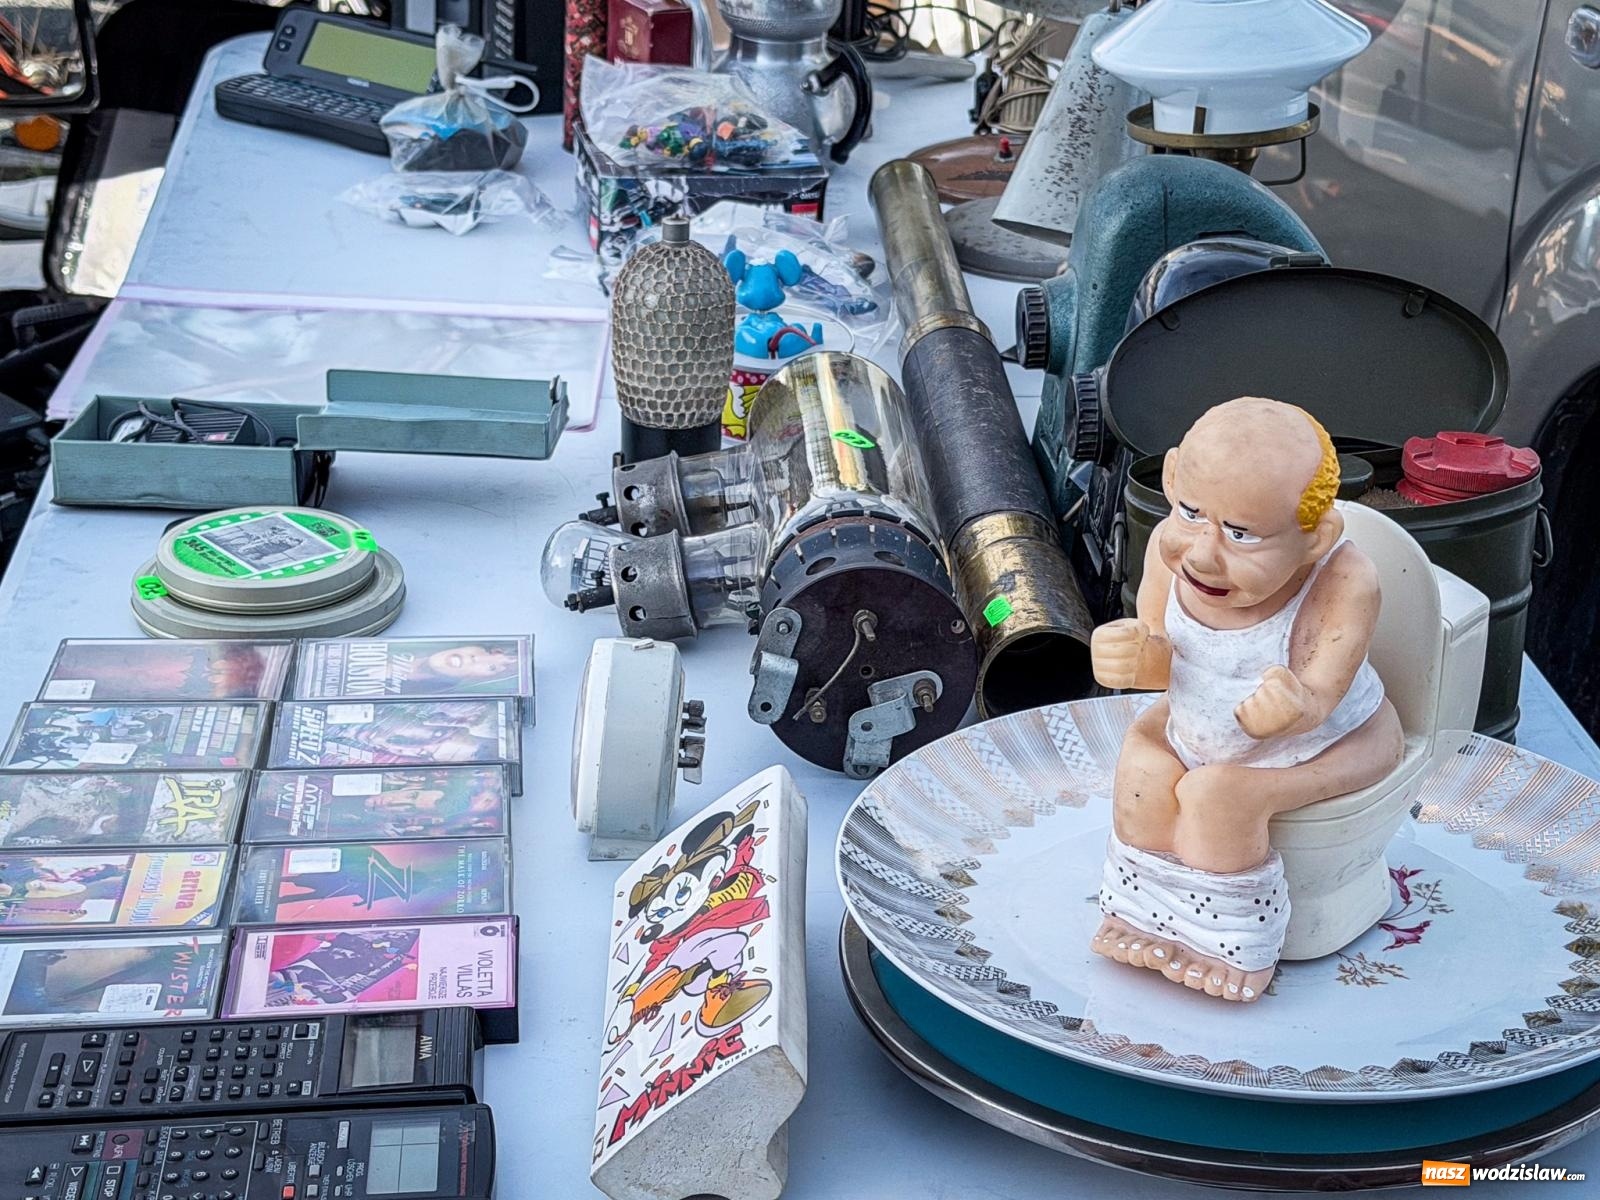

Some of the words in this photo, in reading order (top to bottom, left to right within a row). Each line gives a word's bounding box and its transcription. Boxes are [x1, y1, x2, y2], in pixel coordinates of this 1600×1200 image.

[346, 643, 387, 696] HOUSTON
[299, 707, 325, 752] SPEED
[297, 751, 320, 765] 2
[175, 871, 202, 909] arriva
[456, 891, 464, 913] ZORRO
[164, 936, 199, 1017] TWISTER
[457, 964, 473, 998] VILLAS
[477, 950, 493, 997] VIOLETTA
[418, 1035, 432, 1060] AIWA
[606, 1022, 747, 1148] MINNIE
[270, 1119, 282, 1144] BETRIEB
[103, 1179, 117, 1197] STOP
